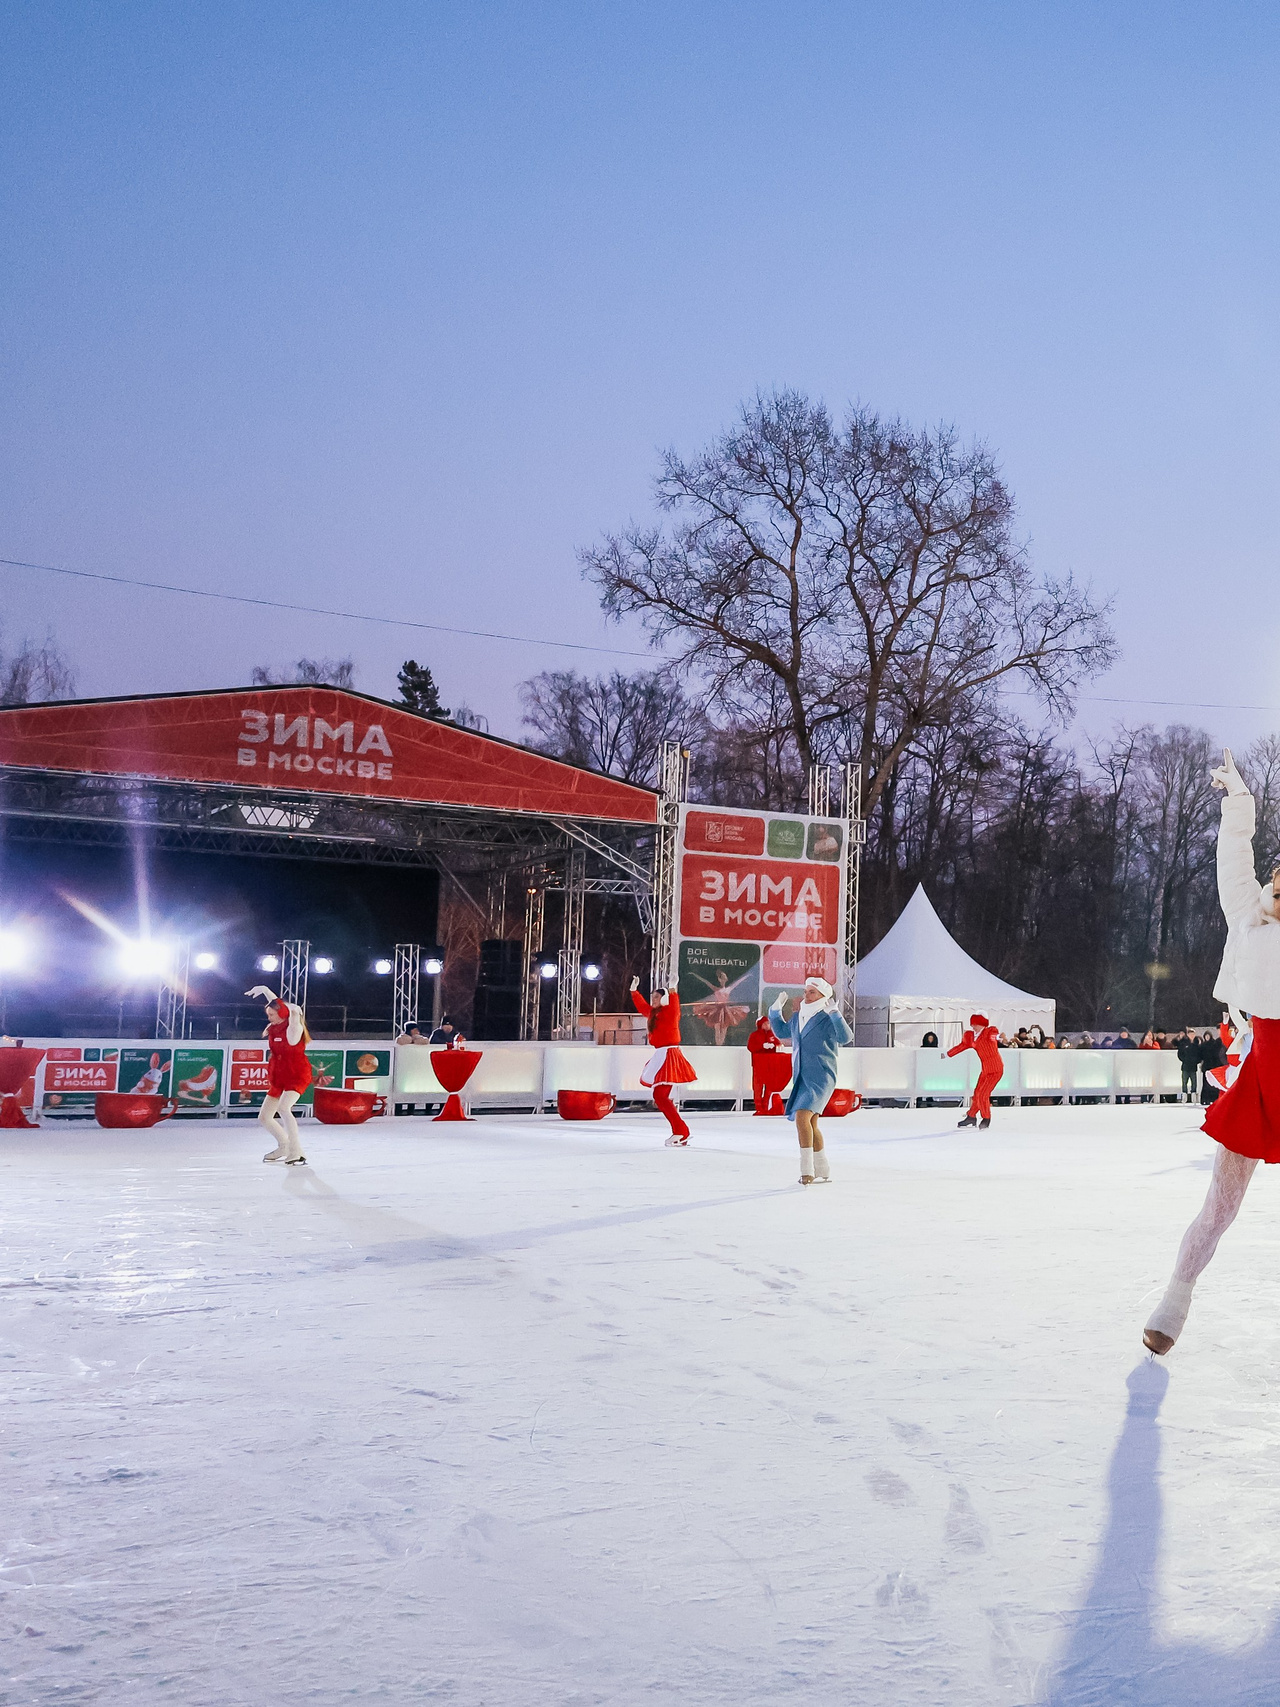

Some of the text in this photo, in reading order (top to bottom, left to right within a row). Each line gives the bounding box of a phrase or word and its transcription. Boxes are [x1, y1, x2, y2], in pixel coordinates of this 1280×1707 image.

[238, 708, 394, 758] ЗИМА
[237, 748, 393, 781] В МОСКВЕ
[700, 869, 823, 908] ЗИМА
[700, 906, 823, 930] В МОСКВЕ
[687, 956, 748, 967] ТАНЦЕВАТЬ!
[54, 1067, 108, 1079] ЗИМА
[63, 1079, 107, 1087] МОСКВЕ
